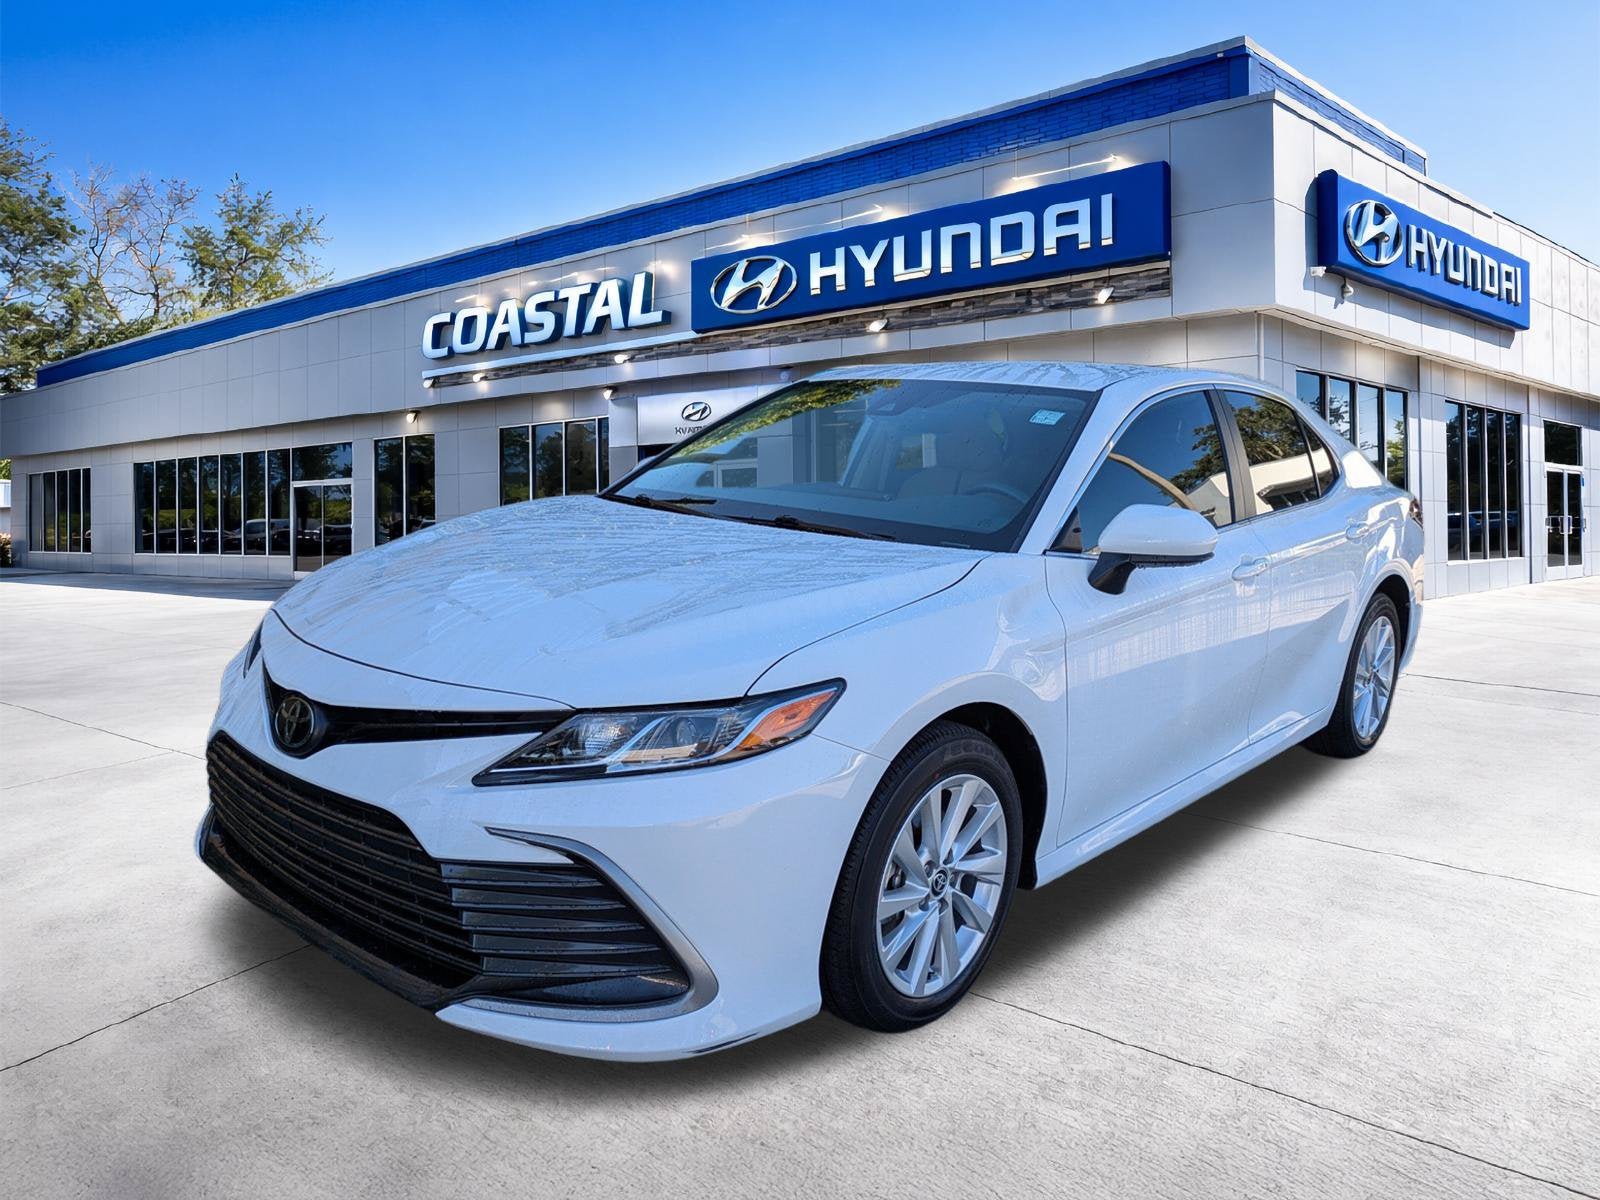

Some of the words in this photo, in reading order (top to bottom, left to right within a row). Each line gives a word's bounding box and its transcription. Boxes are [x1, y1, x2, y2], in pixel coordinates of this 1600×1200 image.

[810, 193, 1112, 295] HYUNDAI
[1406, 224, 1521, 306] HYUNDAI
[422, 271, 666, 359] COASTAL
